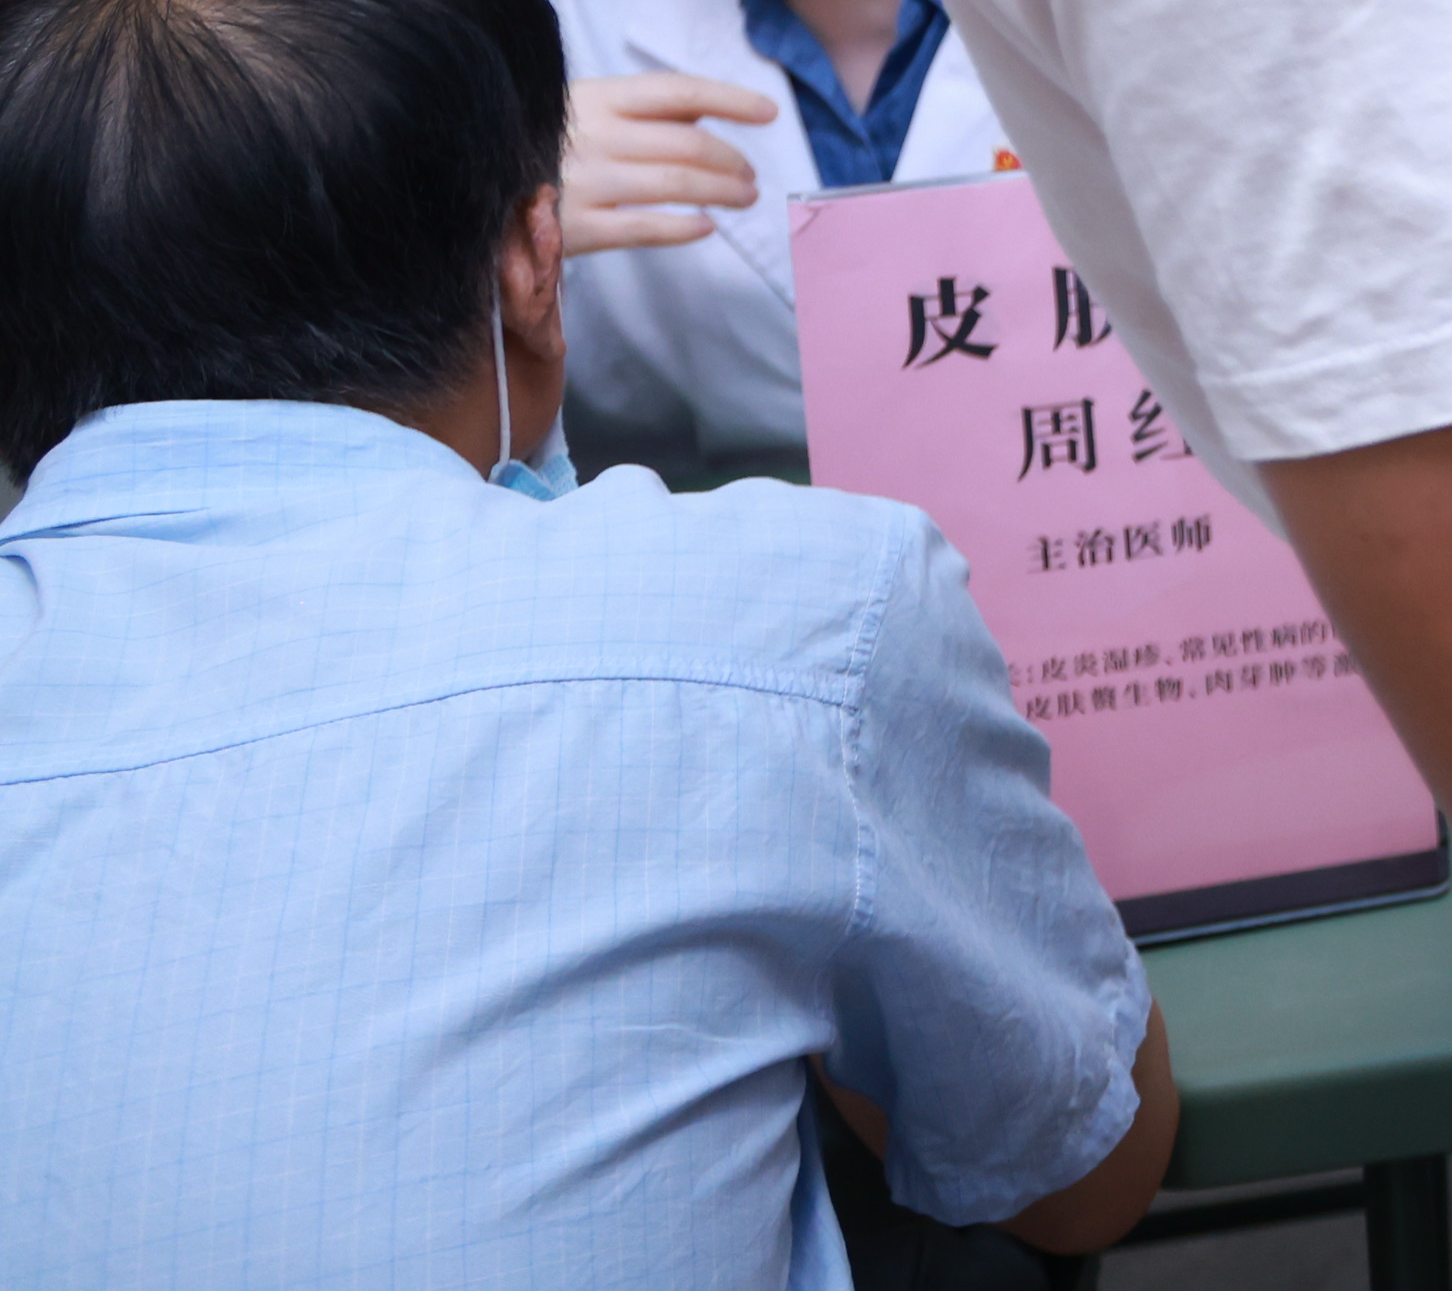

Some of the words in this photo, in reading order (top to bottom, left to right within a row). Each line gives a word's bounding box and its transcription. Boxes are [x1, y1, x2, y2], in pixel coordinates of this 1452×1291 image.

[1026, 511, 1214, 575] 主治医师
[1008, 620, 1337, 688] ：皮炎湿疹、常见性病的
